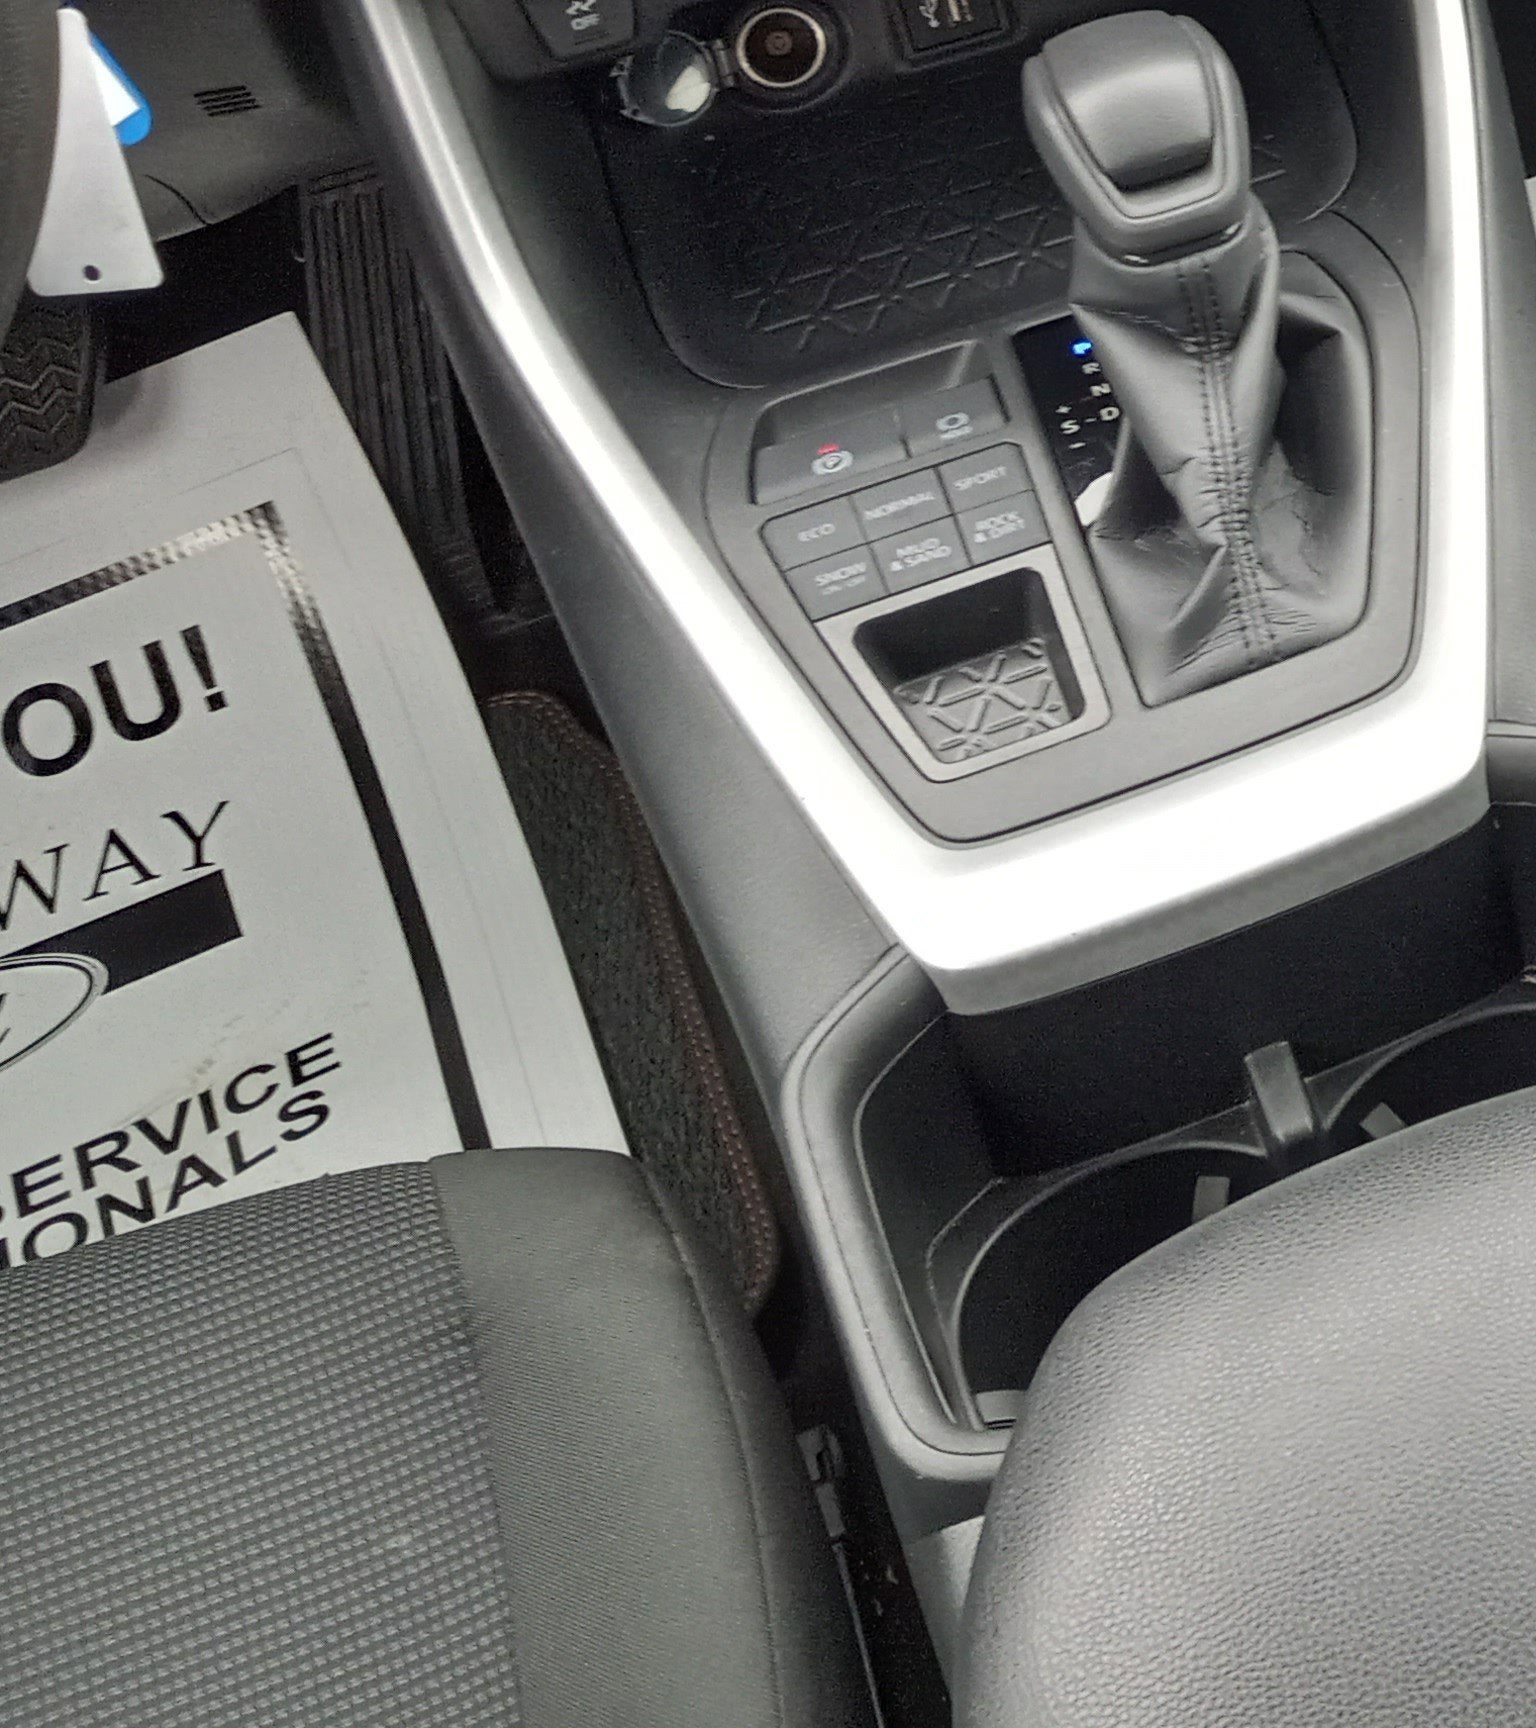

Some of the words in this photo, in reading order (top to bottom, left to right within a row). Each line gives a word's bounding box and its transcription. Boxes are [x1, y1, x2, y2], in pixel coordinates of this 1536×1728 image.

[1091, 383, 1111, 397] N
[1060, 419, 1080, 434] S
[1100, 406, 1120, 421] D
[953, 465, 1007, 492] SPORT
[0, 1032, 342, 1220] ERVICE
